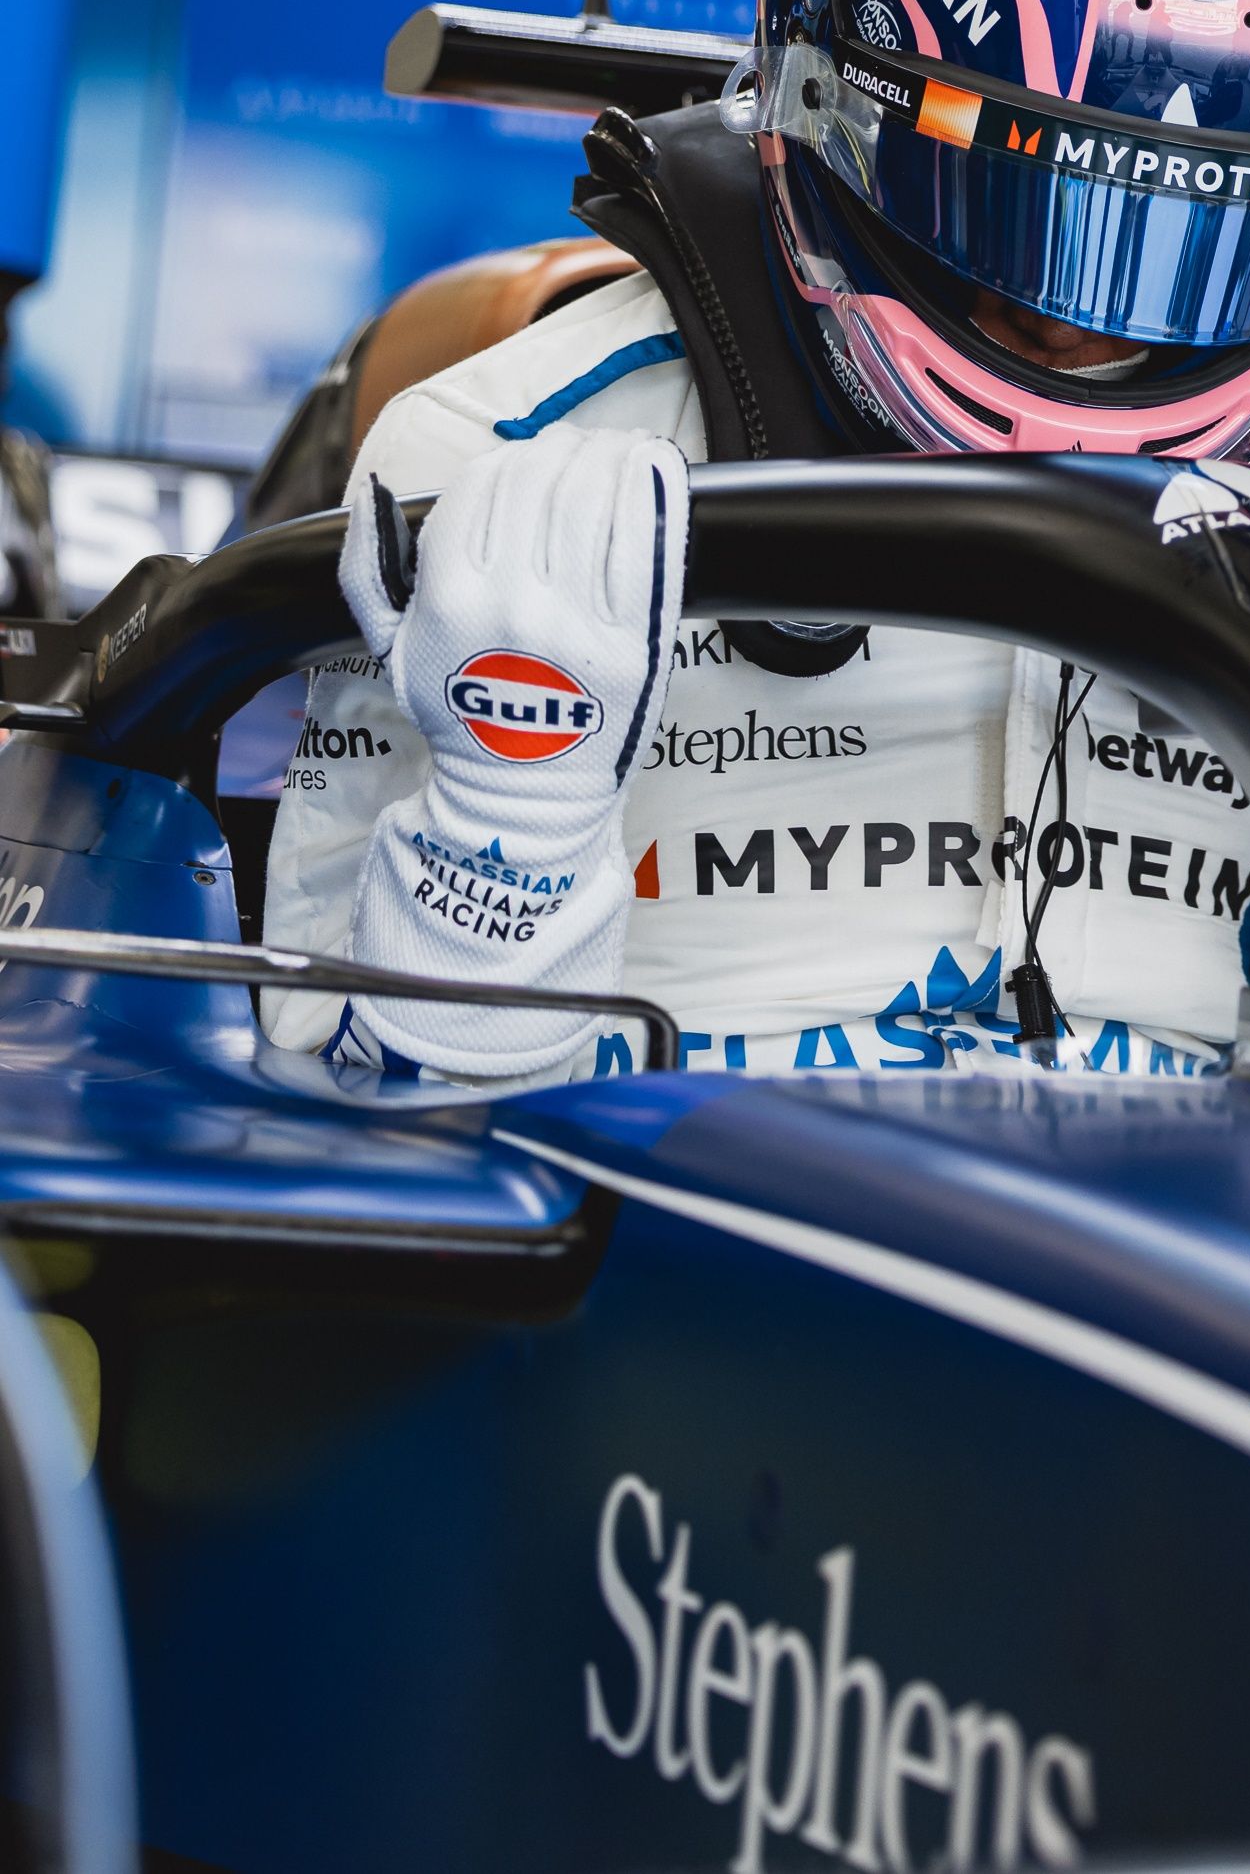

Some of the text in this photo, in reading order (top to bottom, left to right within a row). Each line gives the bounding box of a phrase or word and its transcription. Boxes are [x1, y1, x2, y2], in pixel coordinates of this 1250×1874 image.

[843, 62, 910, 107] DURACELL
[823, 329, 889, 427] MONSOON
[452, 681, 594, 728] Gulf
[412, 832, 575, 895] ATLASSIAN
[416, 847, 563, 919] WILLIAMS
[414, 878, 536, 942] RACING
[586, 1474, 1095, 1874] Stephens
